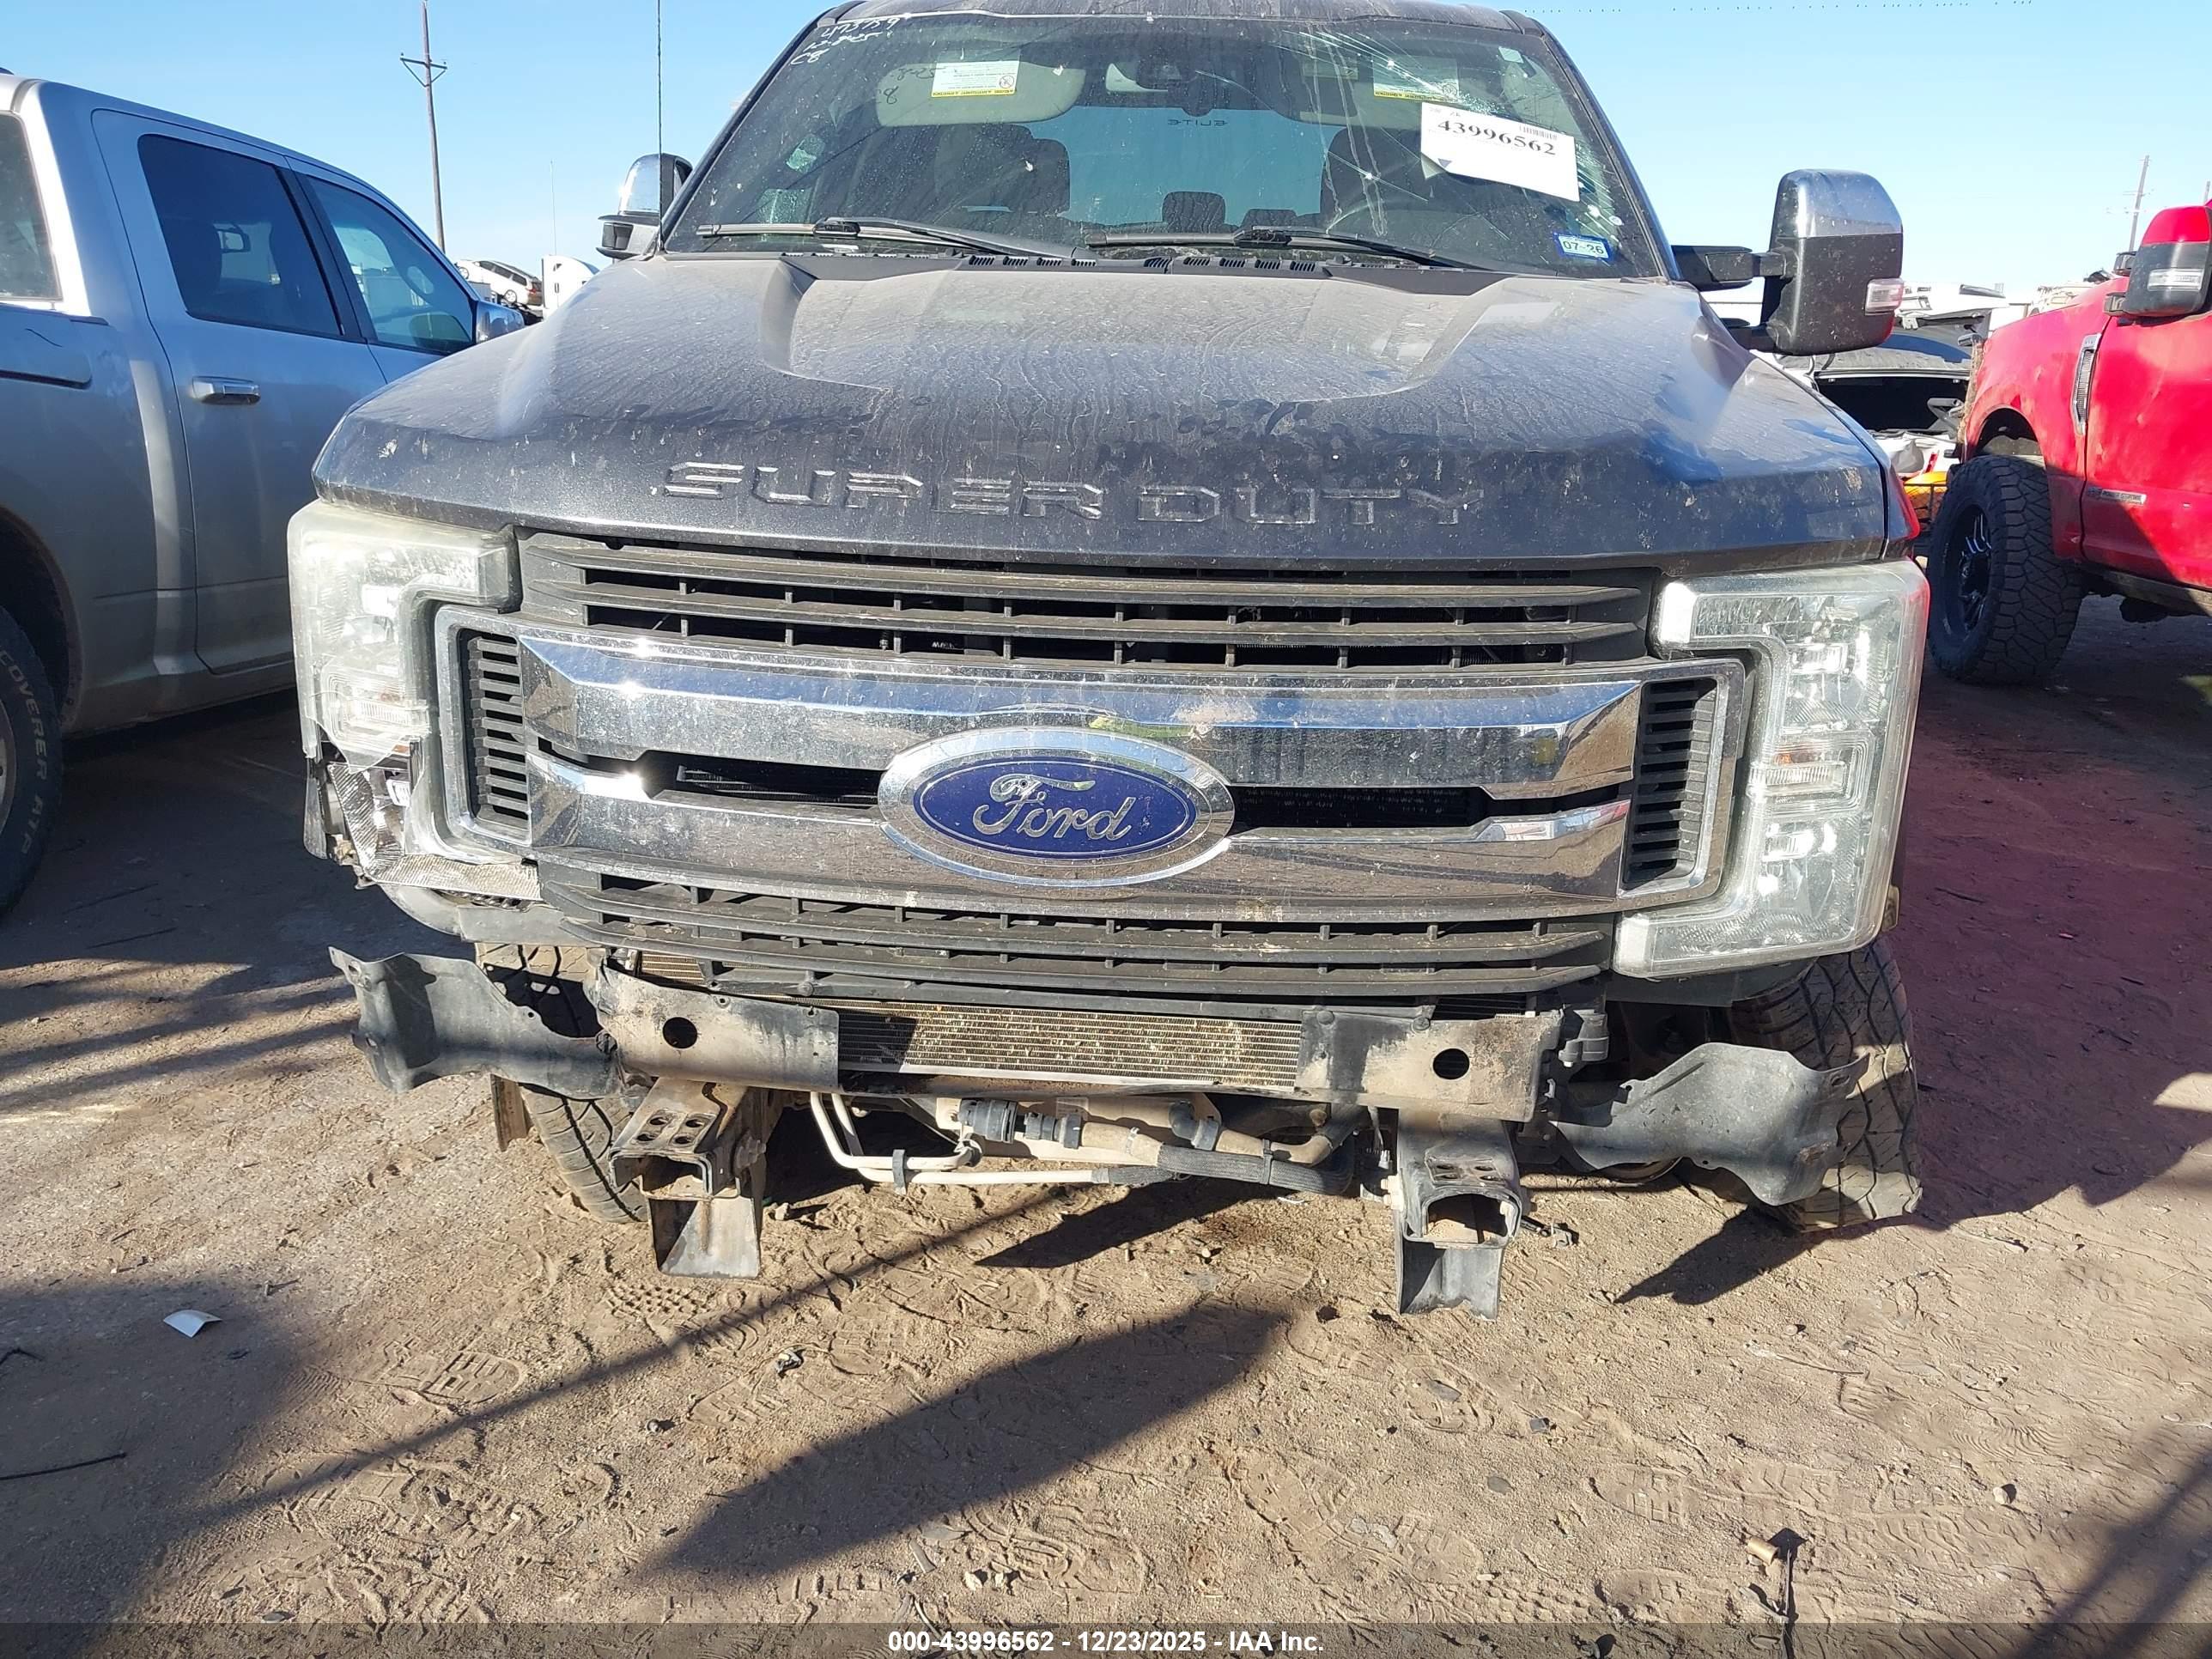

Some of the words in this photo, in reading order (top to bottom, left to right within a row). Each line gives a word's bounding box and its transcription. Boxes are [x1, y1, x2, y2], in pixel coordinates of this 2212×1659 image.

[1437, 119, 1557, 155] 43996562
[1563, 240, 1605, 255] 07-26
[664, 461, 1103, 520] SUPER
[1136, 485, 1484, 525] DUTY
[0, 644, 47, 780] COVERER
[972, 773, 1136, 841] Ford
